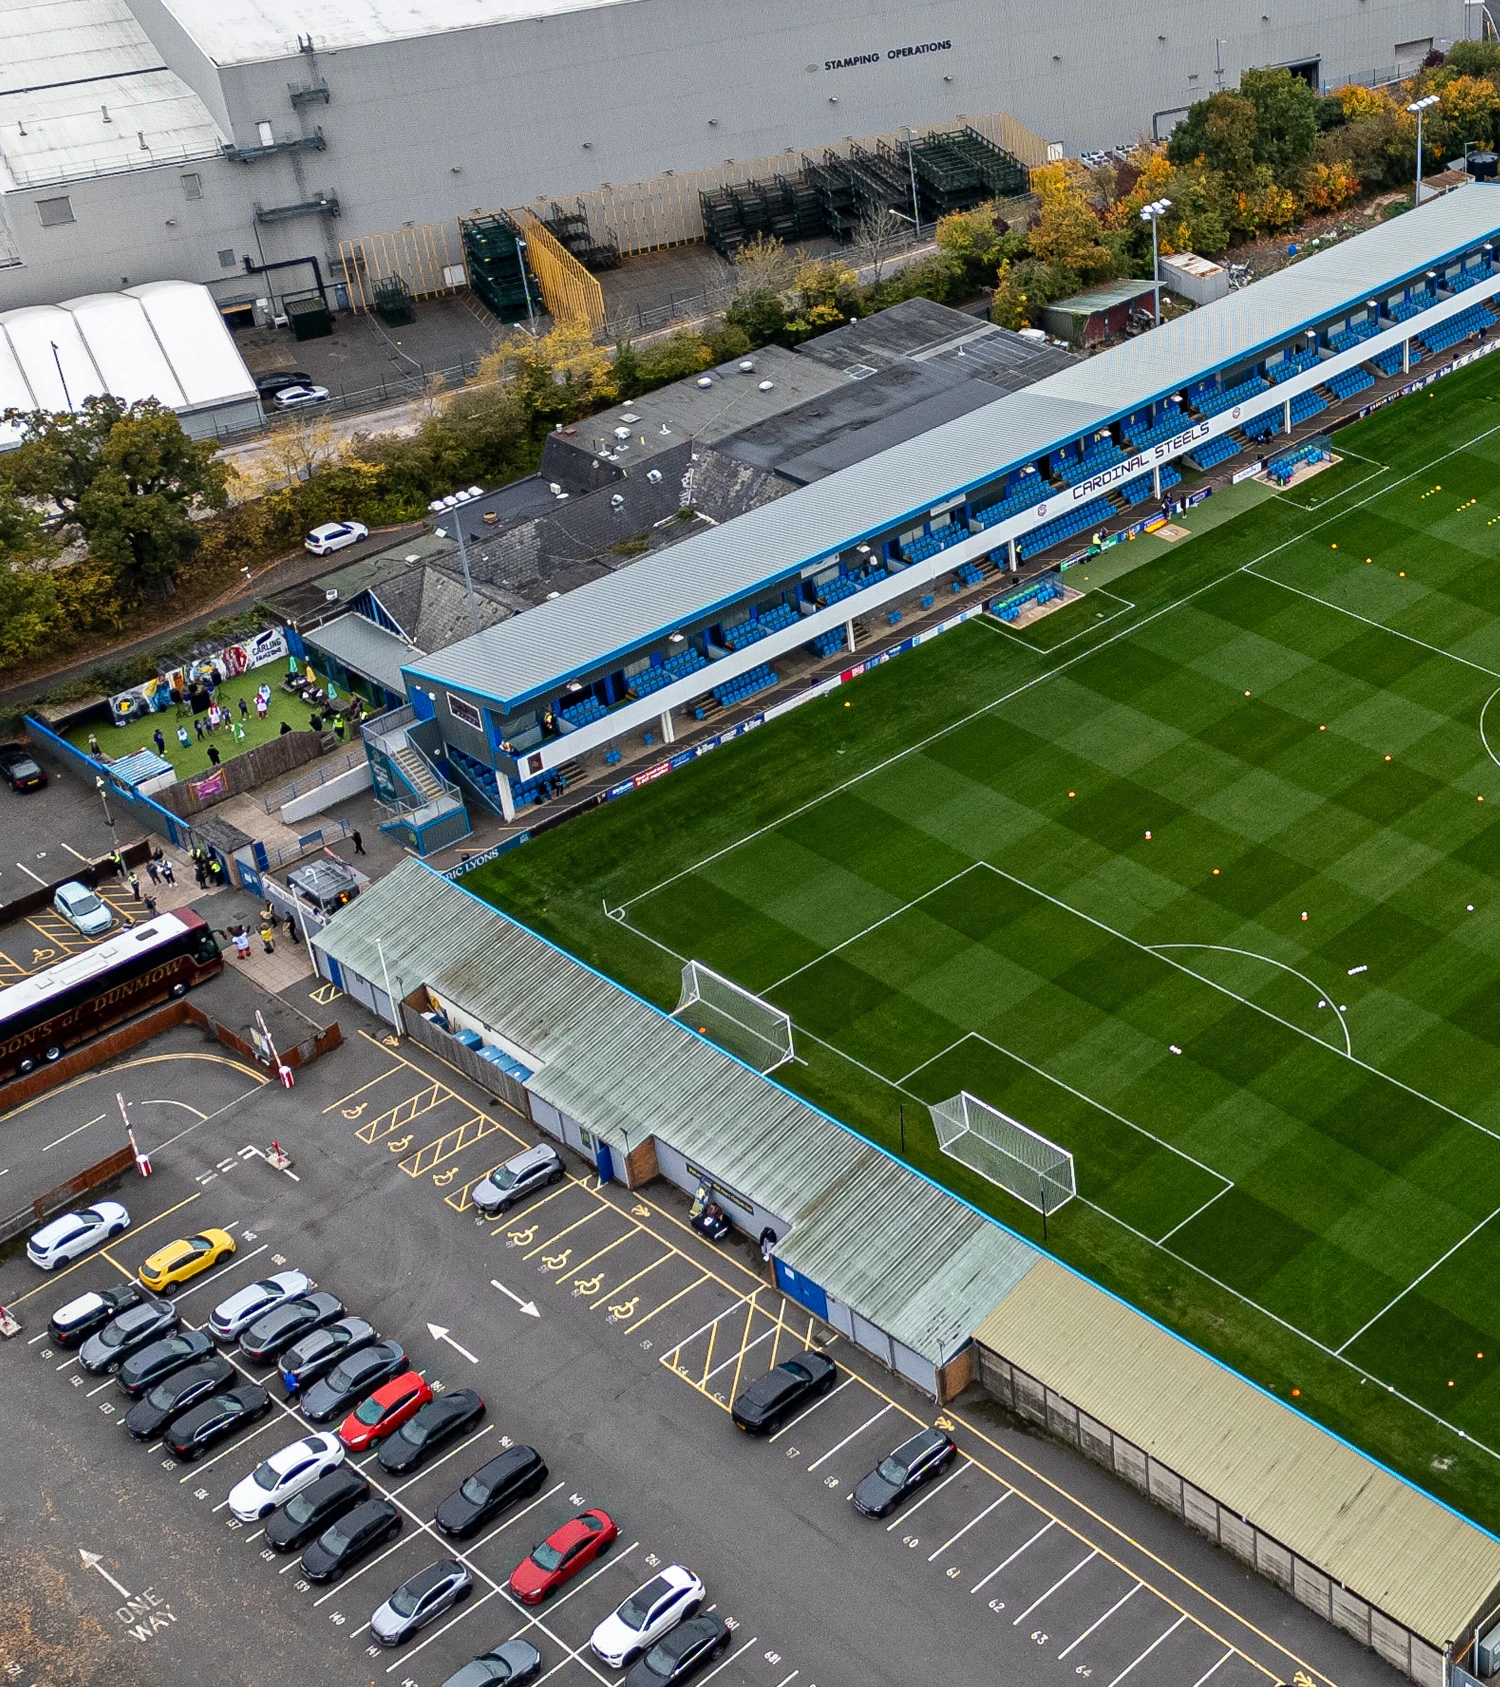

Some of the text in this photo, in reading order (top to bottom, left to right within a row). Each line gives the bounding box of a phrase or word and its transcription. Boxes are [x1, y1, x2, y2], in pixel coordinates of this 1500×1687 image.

[825, 40, 952, 70] STAMPING OPERATIONS
[1072, 421, 1210, 500] CARDINAL STEELS
[252, 637, 282, 656] CARLING
[465, 849, 499, 871] LYONS
[63, 1008, 80, 1027] of
[93, 958, 184, 1012] DUNMOW
[99, 1402, 116, 1415] 133
[786, 1446, 801, 1459] 57
[824, 1475, 839, 1488] 58
[193, 1487, 210, 1500] 136
[225, 1517, 243, 1530] 137
[902, 1535, 919, 1548] 60
[259, 1548, 276, 1562] 138
[645, 1553, 661, 1568] 192
[946, 1567, 961, 1579] 61
[293, 1580, 310, 1593] 139
[116, 1586, 164, 1624] ONE
[988, 1599, 1006, 1613] 62
[128, 1604, 178, 1643] WAY
[328, 1611, 346, 1625] 140
[723, 1616, 740, 1631] 190
[1030, 1631, 1049, 1645] 63
[365, 1645, 382, 1658] 141
[764, 1650, 782, 1665] 189
[1075, 1665, 1092, 1679] 64
